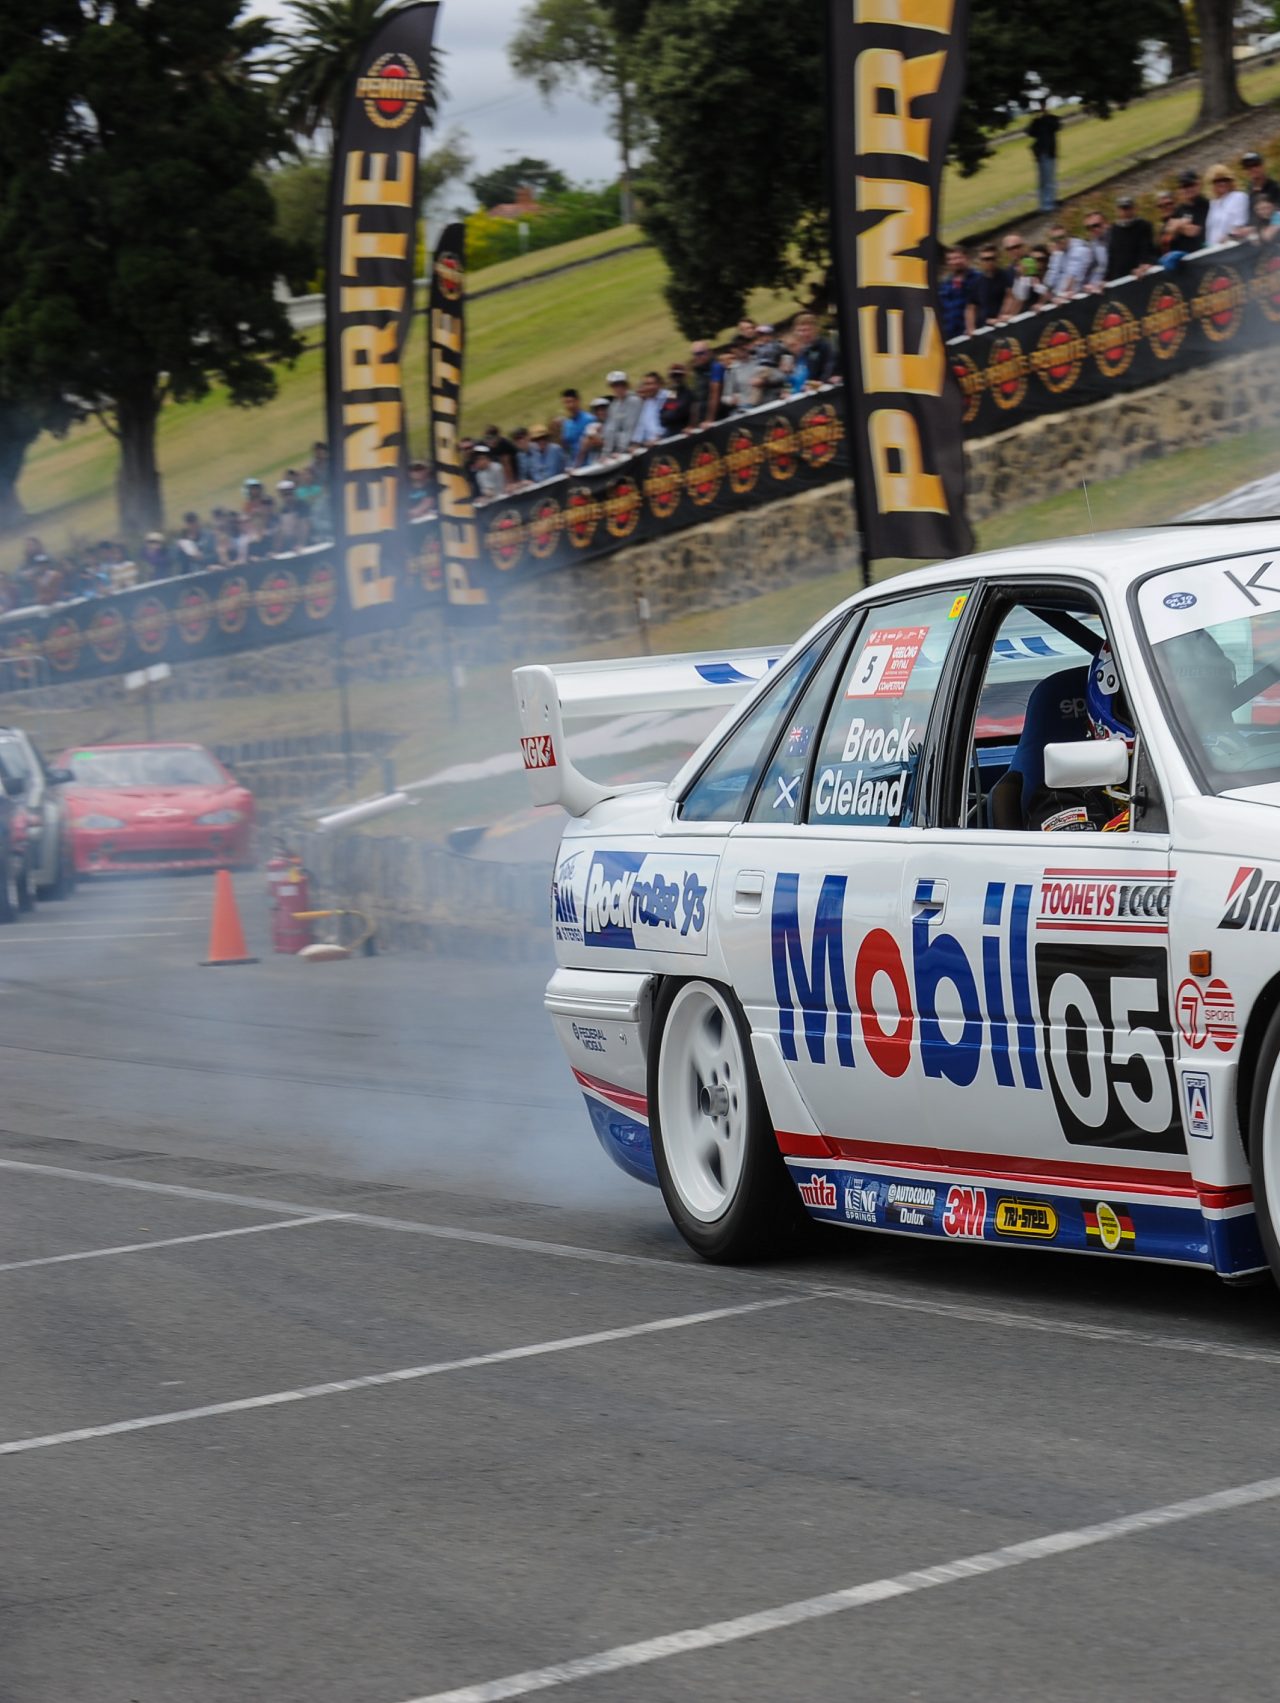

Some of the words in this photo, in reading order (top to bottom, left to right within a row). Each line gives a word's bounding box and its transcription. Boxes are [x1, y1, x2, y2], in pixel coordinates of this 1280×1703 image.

[339, 150, 416, 609] PENRITE
[861, 655, 879, 684] 5
[520, 737, 548, 768] NGK
[841, 717, 915, 762] Brock
[815, 769, 907, 816] Cleland
[1041, 883, 1117, 916] TOOHEYS
[1118, 885, 1173, 917] 1000
[771, 872, 1043, 1090] Mobil
[1205, 1009, 1236, 1022] SPORT
[1048, 973, 1173, 1134] 05
[799, 1175, 836, 1207] mita
[896, 1185, 936, 1206] AUTOCOLOR
[845, 1211, 877, 1223] SPRINGS
[900, 1208, 925, 1226] Dulux
[943, 1186, 986, 1239] 3M
